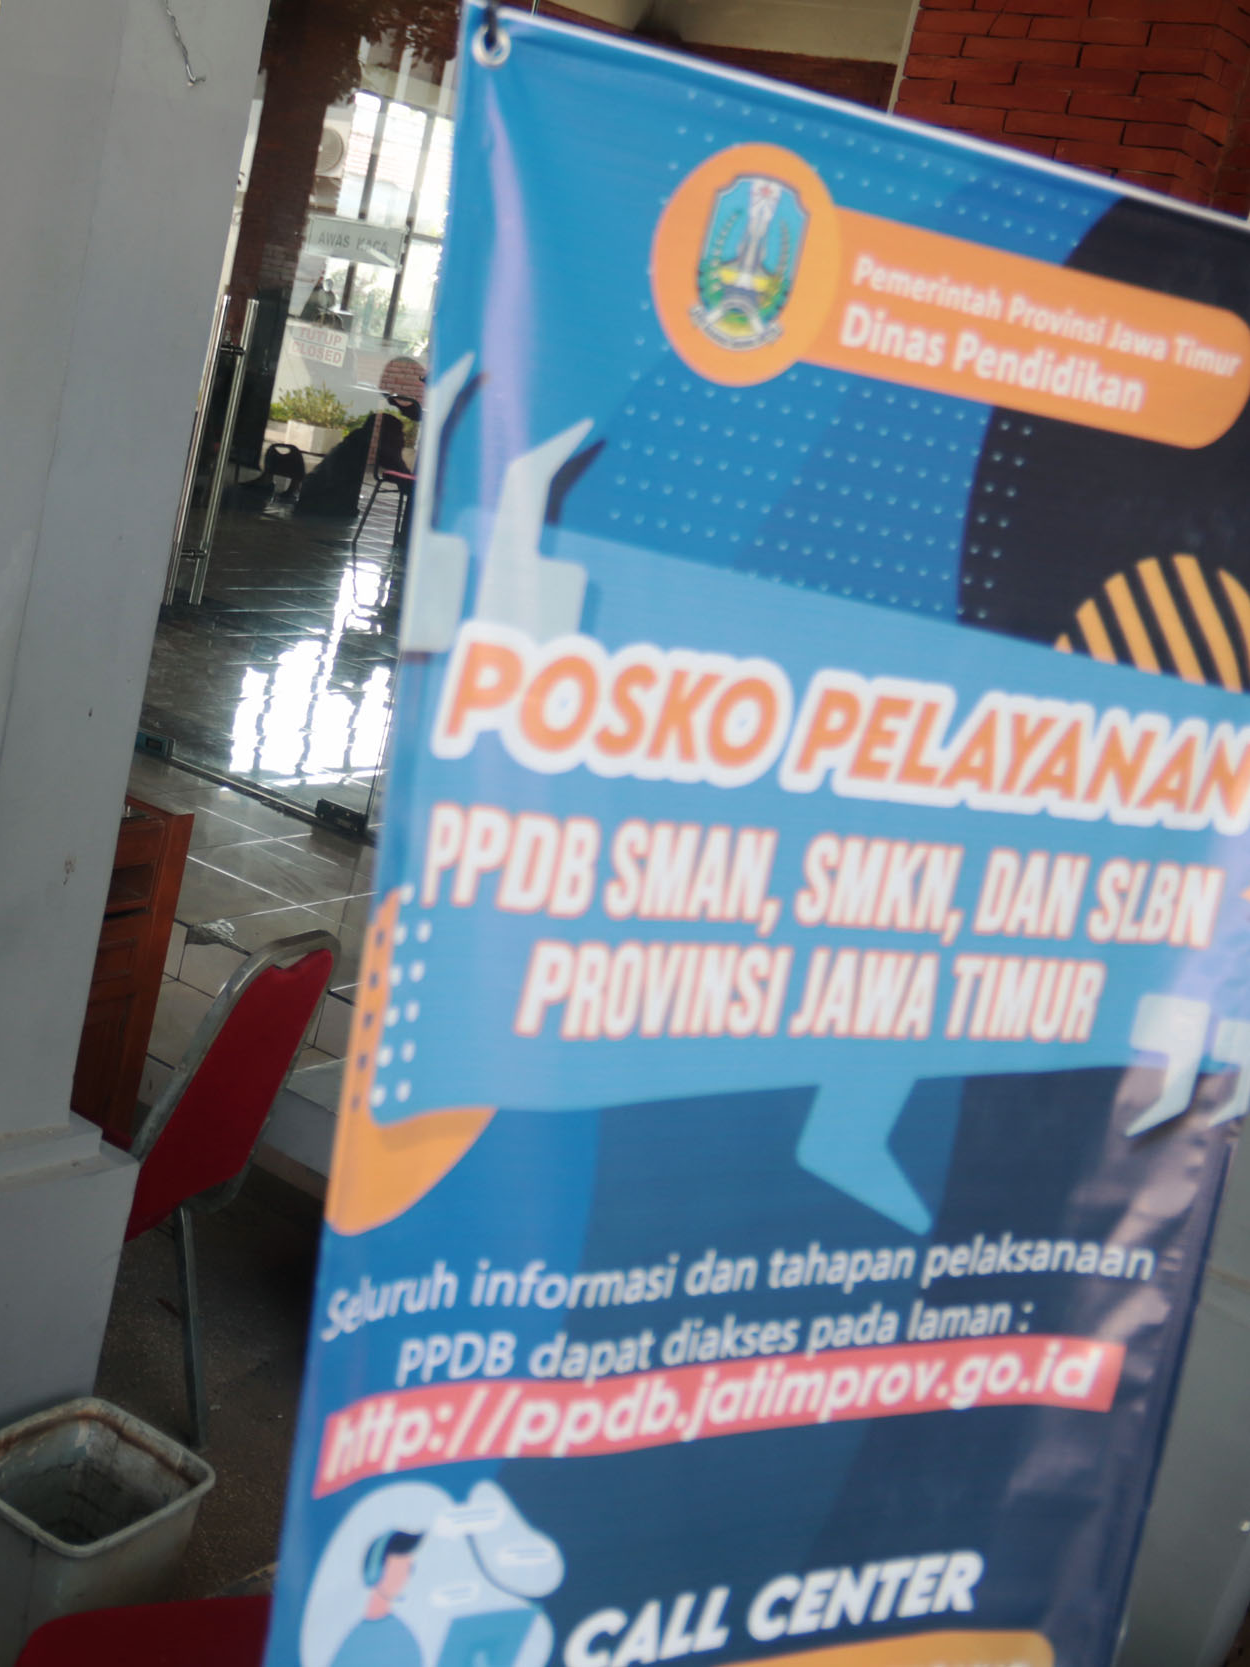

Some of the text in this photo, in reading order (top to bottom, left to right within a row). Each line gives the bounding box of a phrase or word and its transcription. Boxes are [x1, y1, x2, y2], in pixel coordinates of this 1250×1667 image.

[317, 231, 350, 249] AWAS
[300, 326, 343, 346] TUTUP
[840, 303, 947, 367] Dinas
[952, 330, 1146, 413] Pendidikan
[852, 253, 1243, 378] Pemerintah Provinsi Jawa Timur
[438, 632, 1250, 824] POSKO PELAYANAN
[421, 803, 1225, 950] PPDB SMAN, SMKN, DAN SLBN
[514, 941, 1106, 1043] PROVINSI JAWA TIMUR
[320, 1232, 1155, 1342] Seluruh informasi dan tahapan pelaksanaan
[395, 1331, 517, 1388] PPDB
[528, 1330, 655, 1390] dapat
[662, 1314, 800, 1367] diakses
[806, 1302, 898, 1359] pada
[906, 1301, 1013, 1341] laman
[324, 1341, 1104, 1483] http://ppdb.jatimprov.go.id
[562, 1549, 985, 1667] CALL CENTER
